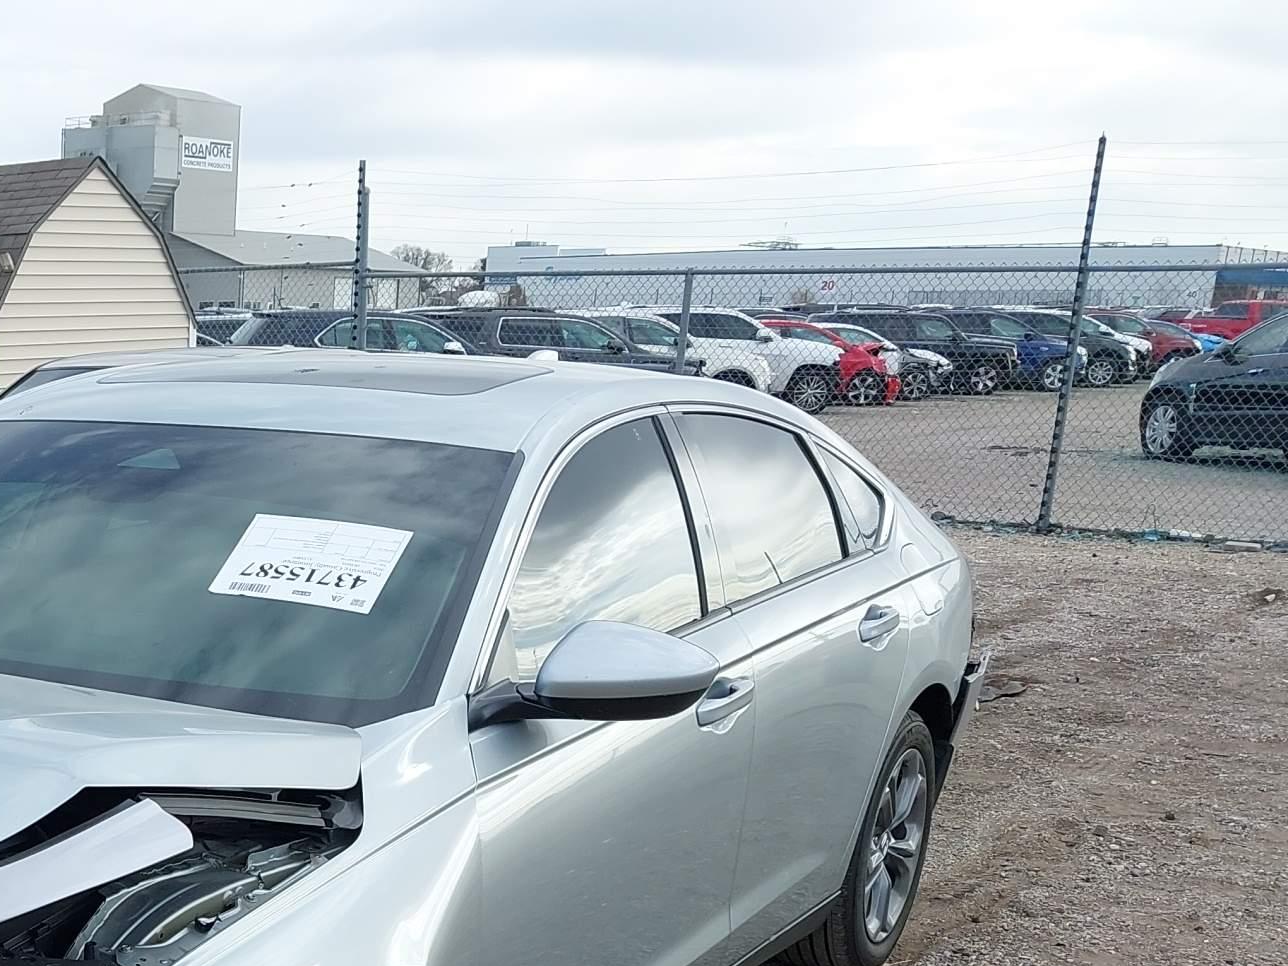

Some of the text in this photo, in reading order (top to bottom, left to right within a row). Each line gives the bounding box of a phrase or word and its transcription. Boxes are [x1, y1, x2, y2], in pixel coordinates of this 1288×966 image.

[183, 142, 232, 159] ROANOKE
[822, 281, 834, 291] 20
[240, 562, 367, 590] 43715587
